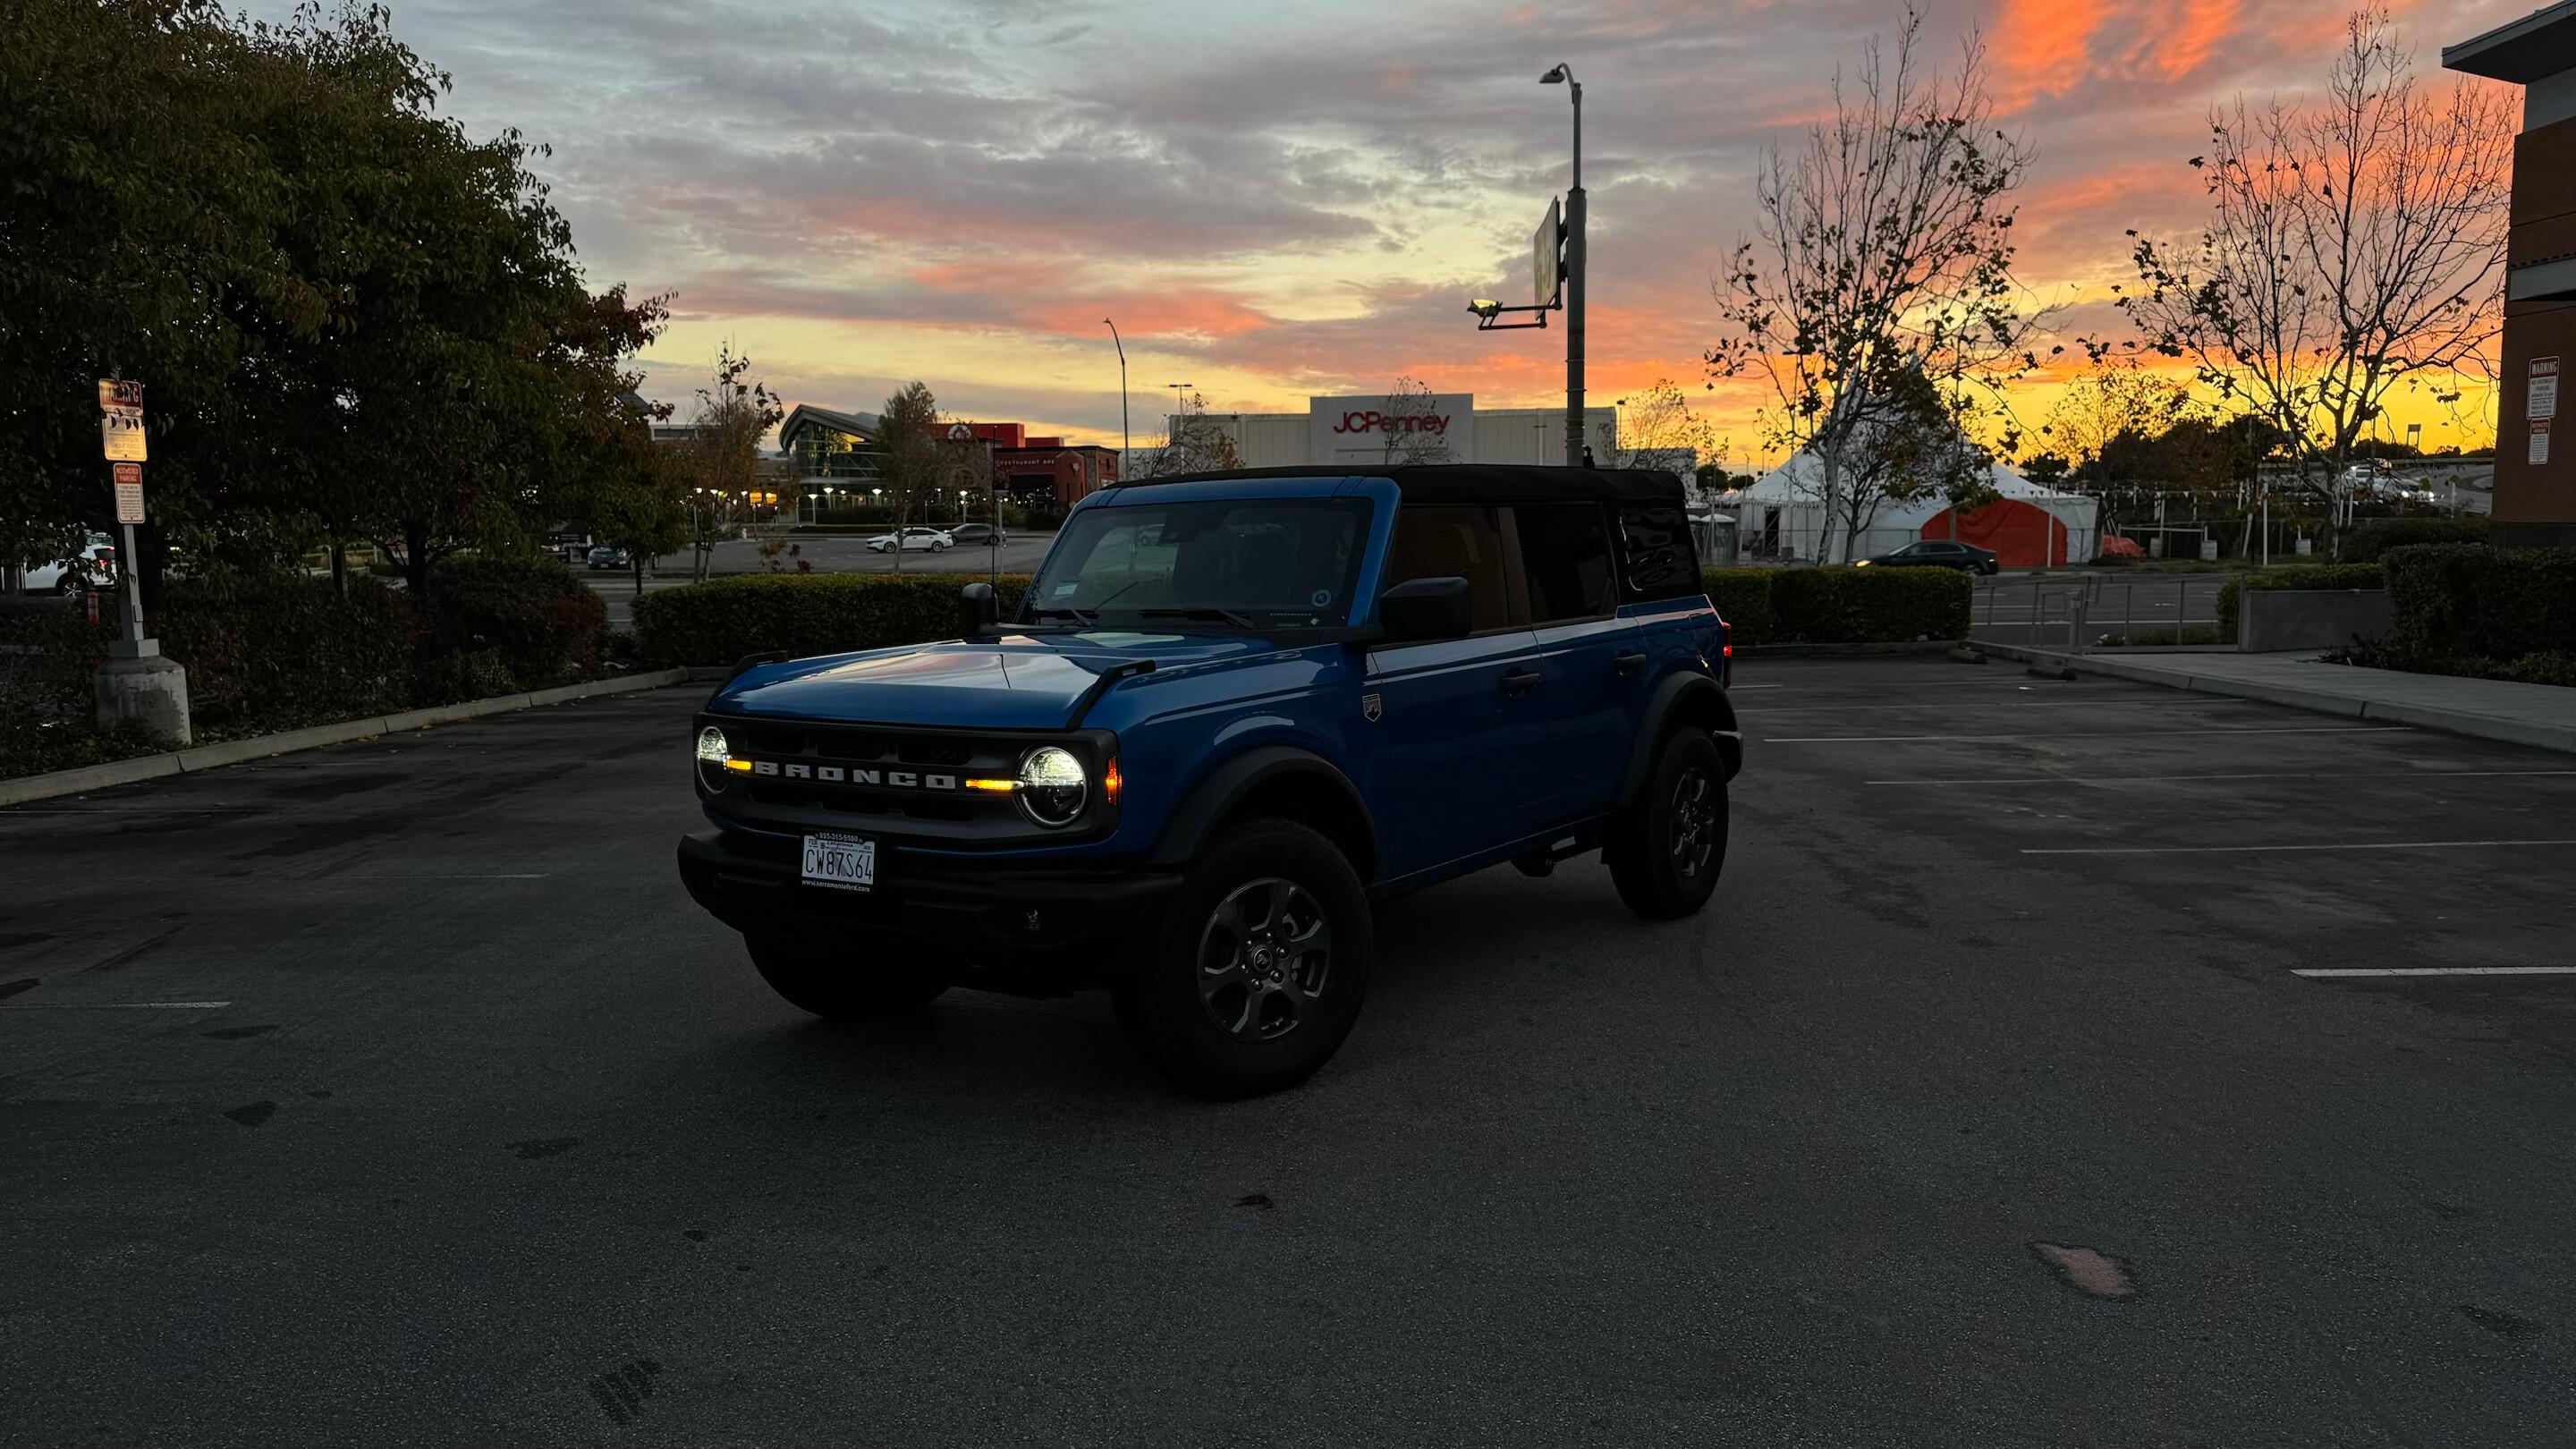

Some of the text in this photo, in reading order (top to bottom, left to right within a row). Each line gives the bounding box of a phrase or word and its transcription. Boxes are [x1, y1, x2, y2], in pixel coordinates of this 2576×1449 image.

[2532, 361, 2557, 374] WARNING
[1334, 411, 1450, 436] JCPenney
[755, 760, 956, 789] BRONCO
[806, 849, 872, 880] CW87S64
